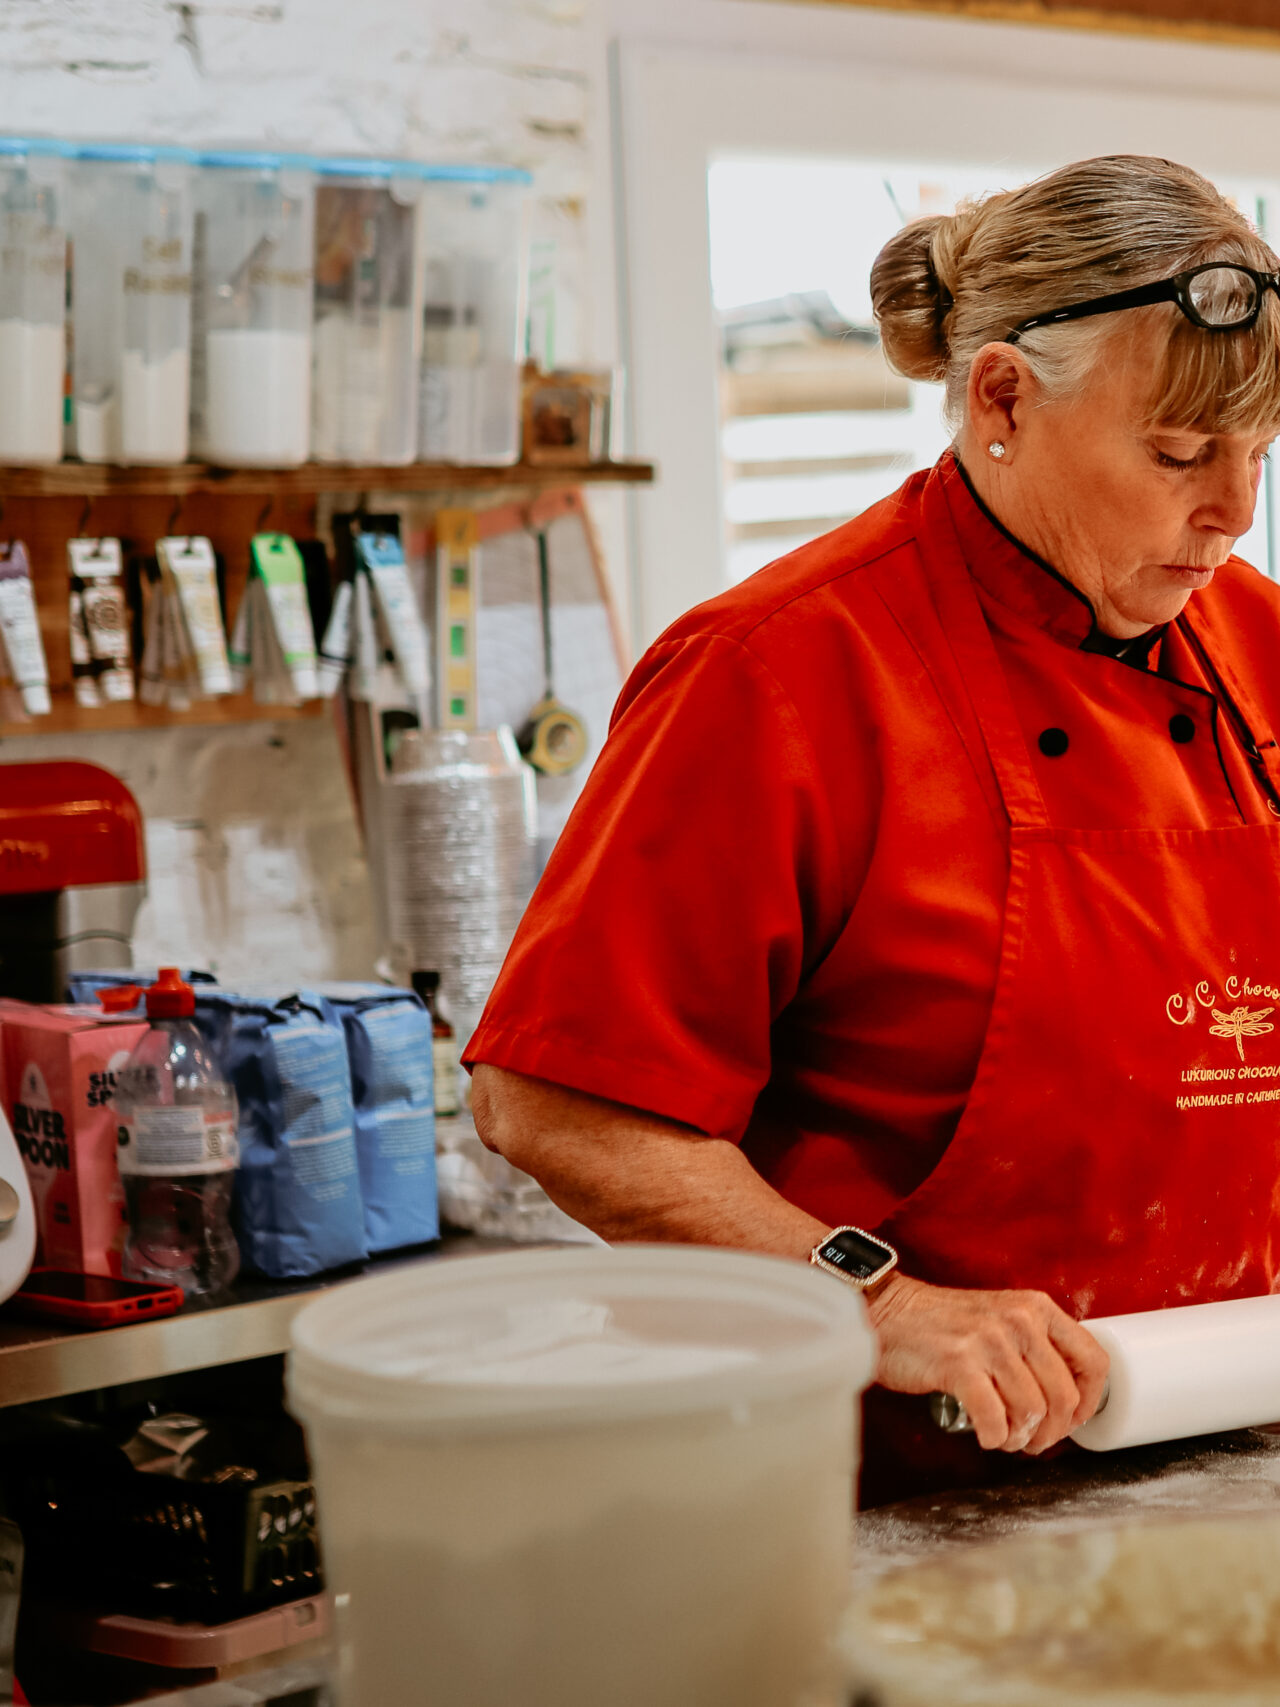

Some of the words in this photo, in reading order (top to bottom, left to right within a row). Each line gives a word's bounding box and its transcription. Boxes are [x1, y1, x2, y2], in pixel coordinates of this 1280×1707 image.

[1166, 993, 1191, 1025] C
[1195, 980, 1216, 1007] C
[1181, 1068, 1236, 1082] LUXURIOUS
[1176, 1093, 1234, 1109] HANDMADE
[1234, 1092, 1245, 1105] IN
[17, 1132, 70, 1171] POON
